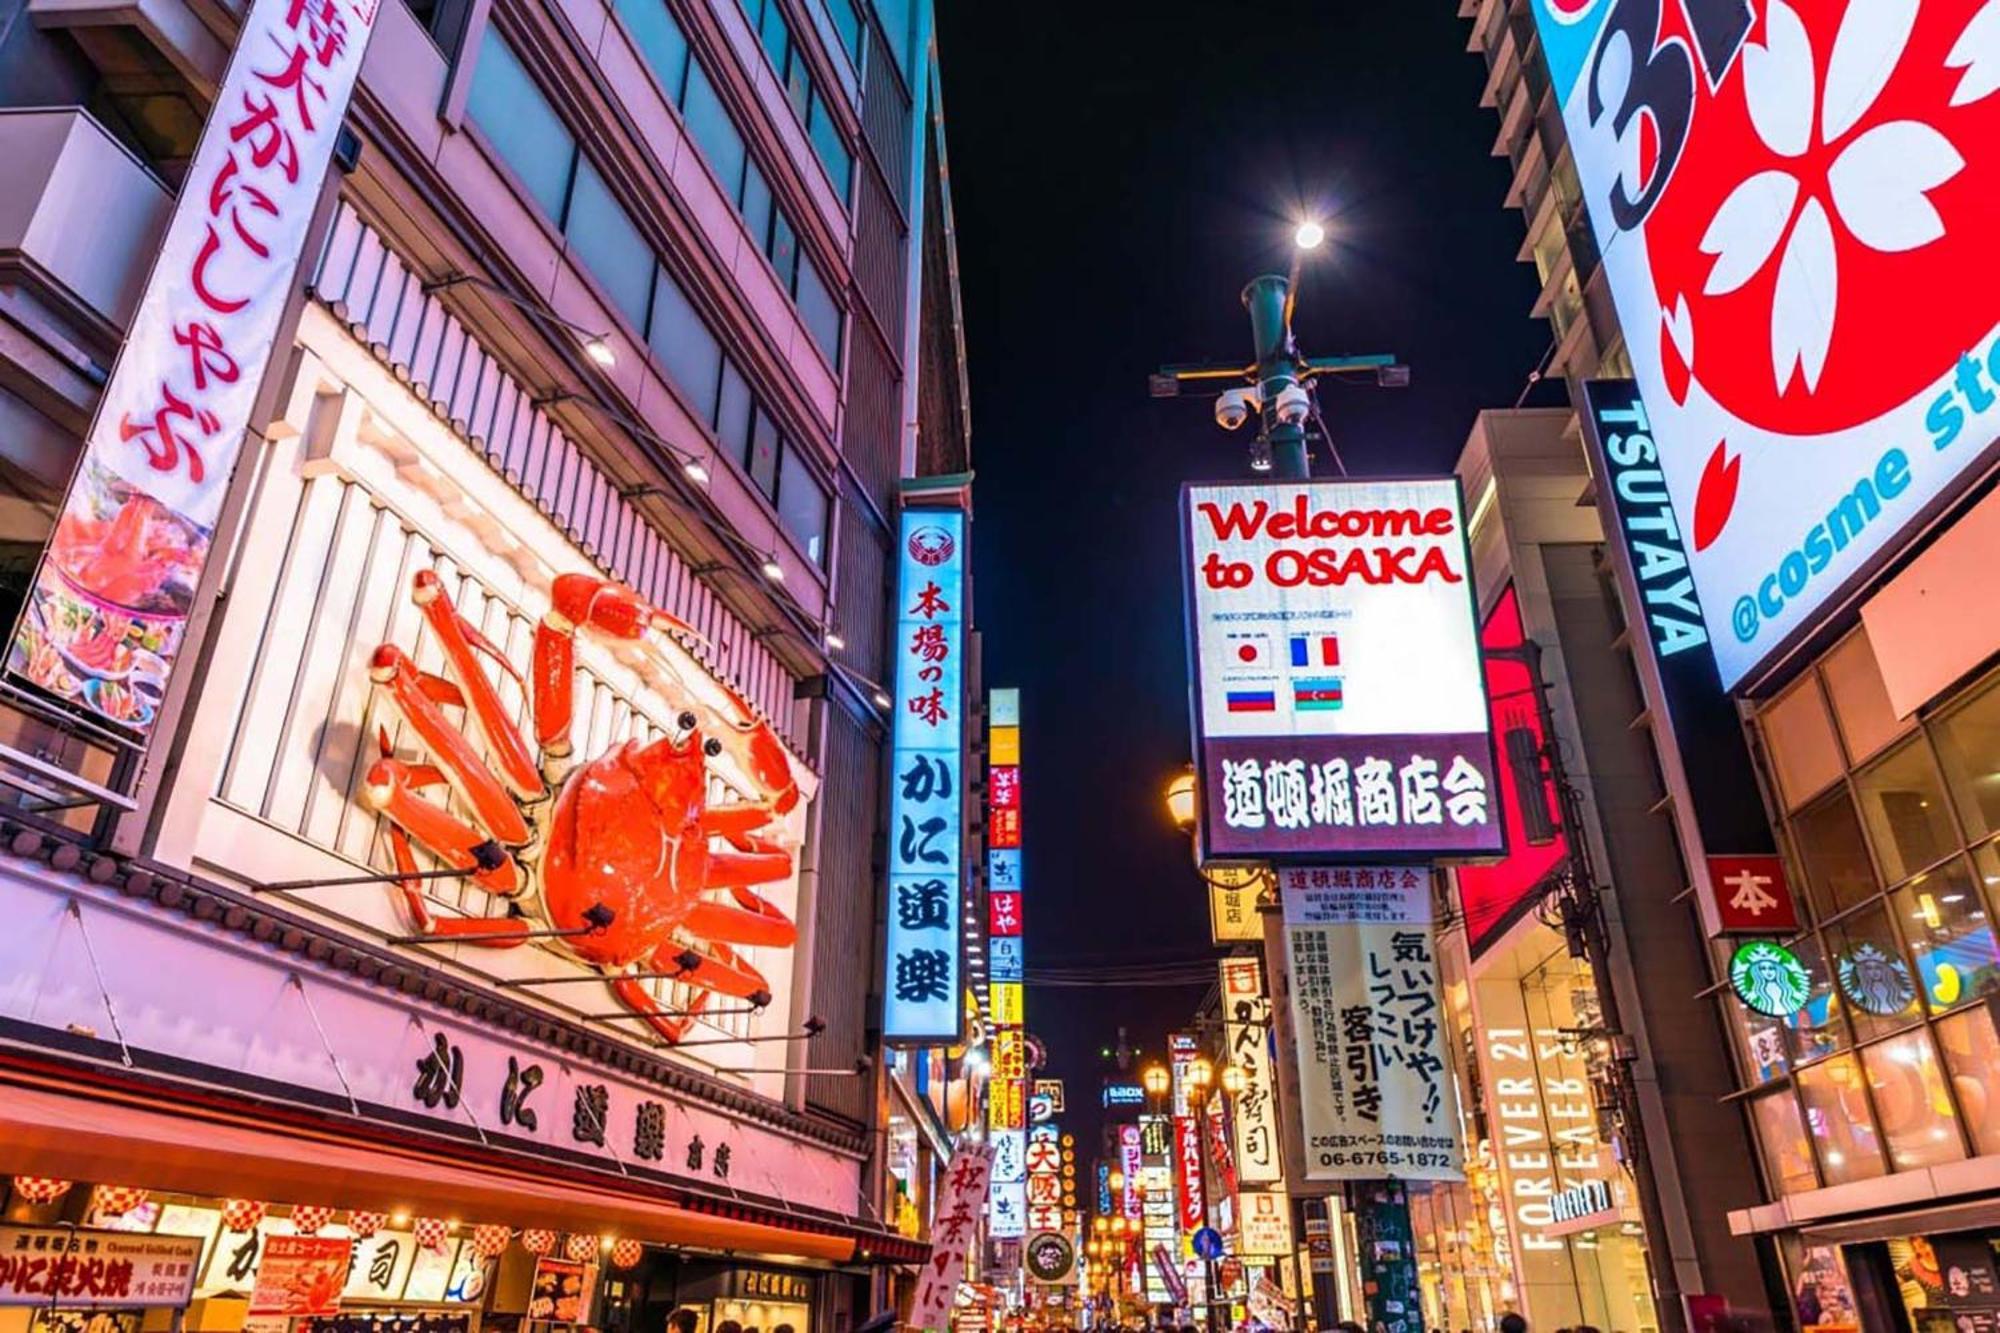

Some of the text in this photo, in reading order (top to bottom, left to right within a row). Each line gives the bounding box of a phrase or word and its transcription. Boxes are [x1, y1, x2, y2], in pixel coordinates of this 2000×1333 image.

[1198, 495, 1454, 541] Welcome
[1600, 400, 1708, 656] TSUTAYA
[1732, 447, 1911, 643] @cosme
[1202, 546, 1463, 589] to OSAKA
[909, 581, 950, 728] 本場の味
[1222, 755, 1488, 829] 道頓堀商店会
[1724, 870, 1778, 916] 本
[1341, 1005, 1382, 1122] 客引き
[1319, 1152, 1450, 1167] 06-6765-1872
[1488, 1028, 1564, 1251] FOREVER 21
